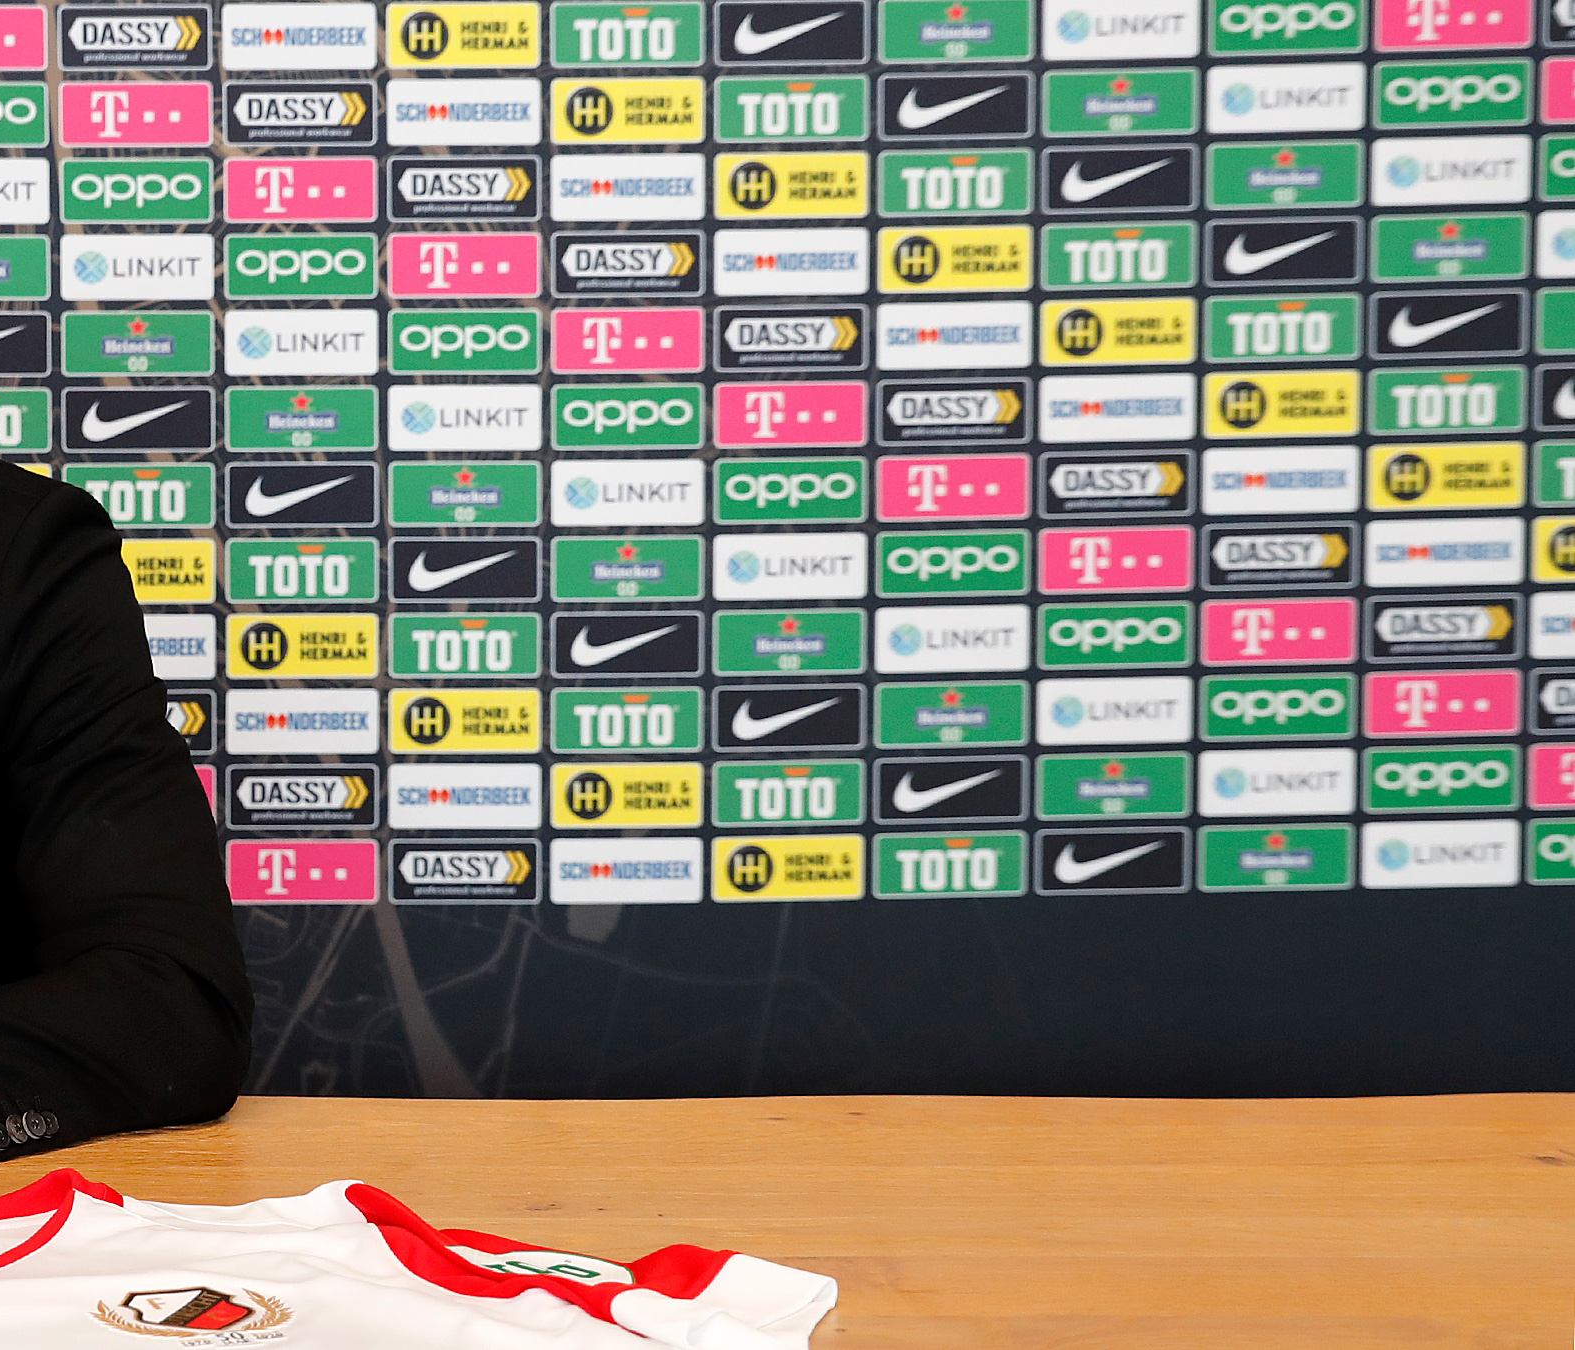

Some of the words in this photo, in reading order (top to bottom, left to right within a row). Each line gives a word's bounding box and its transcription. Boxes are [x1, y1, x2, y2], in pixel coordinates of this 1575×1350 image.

[83, 22, 168, 43] DASSY
[461, 22, 507, 33] HENRI
[1097, 15, 1186, 36] LINKIT
[461, 38, 528, 50] HERMAN
[573, 18, 675, 61] TOTO
[1262, 88, 1351, 109] LINKIT
[248, 99, 333, 120] DASSY
[737, 92, 839, 136] TOTO
[1426, 160, 1515, 181] LINKIT
[412, 174, 497, 196] DASSY
[901, 166, 1003, 210] TOTO
[112, 258, 201, 277] LINKIT
[576, 249, 661, 271] DASSY
[1065, 239, 1167, 283] TOTO
[276, 334, 364, 353] LINKIT
[739, 323, 825, 345] DASSY
[1228, 311, 1331, 356] TOTO
[902, 396, 988, 419] DASSY
[1392, 383, 1494, 427] TOTO
[440, 408, 528, 428] LINKIT
[1065, 469, 1151, 491] DASSY
[603, 483, 691, 502] LINKIT
[1228, 541, 1314, 563] DASSY
[136, 559, 182, 569] HENRI
[765, 556, 854, 576] LINKIT
[136, 574, 203, 585] HERMAN
[247, 555, 348, 597] TOTO
[1391, 612, 1477, 635] DASSY
[299, 633, 345, 644] HENRI
[928, 629, 1016, 649] LINKIT
[299, 649, 366, 660] HERMAN
[410, 629, 510, 671] TOTO
[1091, 701, 1179, 721] LINKIT
[572, 703, 673, 745] TOTO
[250, 782, 335, 803] DASSY
[1253, 772, 1341, 793] LINKIT
[735, 776, 835, 819] TOTO
[1416, 842, 1504, 863] LINKIT
[413, 856, 497, 877] DASSY
[897, 849, 998, 891] TOTO
[216, 1332, 245, 1341] 50
